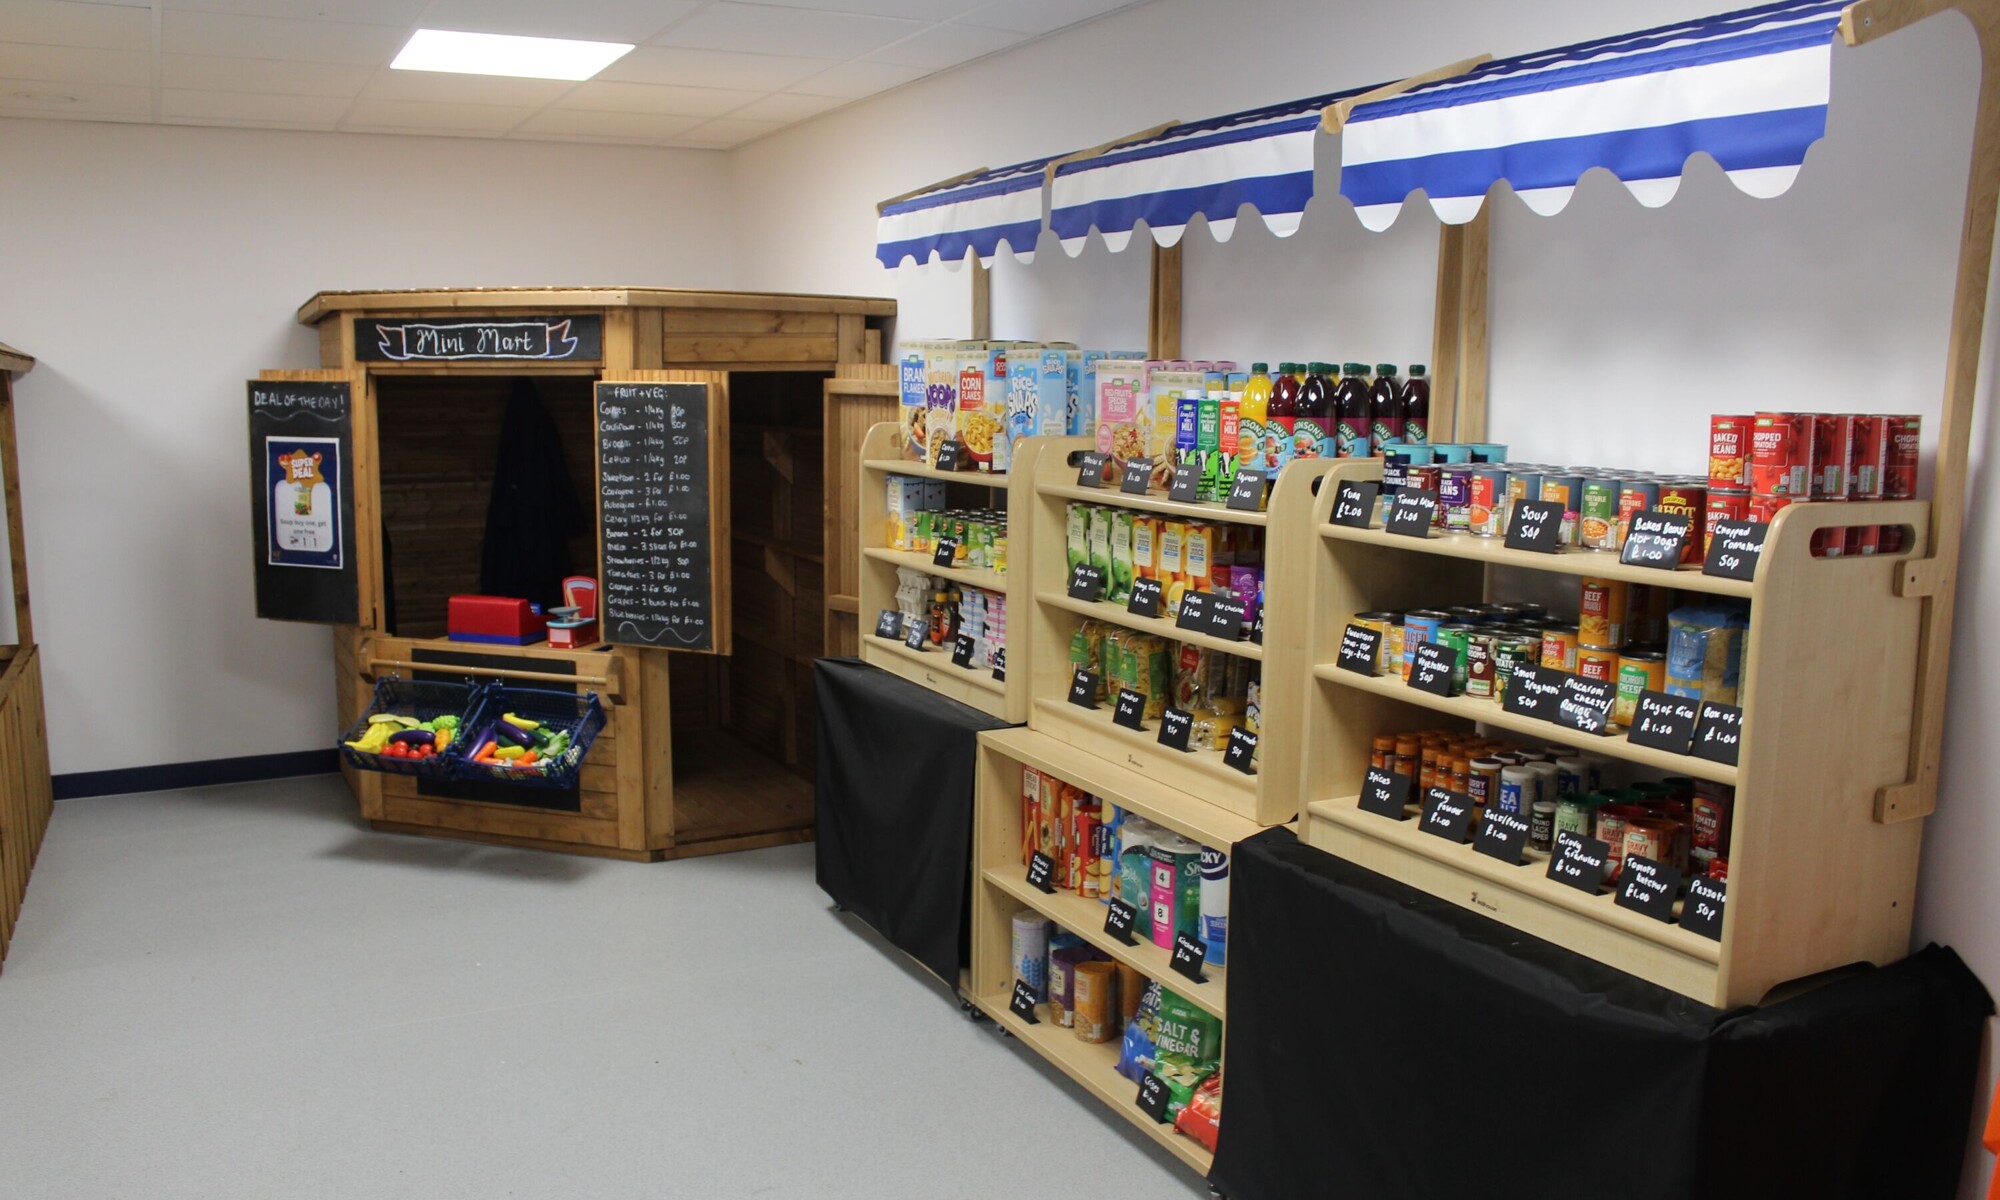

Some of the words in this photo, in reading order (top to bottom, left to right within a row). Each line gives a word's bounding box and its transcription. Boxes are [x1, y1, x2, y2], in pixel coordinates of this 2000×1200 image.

[417, 329, 464, 355] Mini
[477, 328, 533, 353] Mart
[903, 367, 925, 382] BRAN
[903, 382, 925, 394] FLAKES
[961, 377, 982, 391] CORN
[1012, 375, 1033, 391] Rice
[254, 391, 282, 406] DEAL
[284, 394, 296, 406] OF
[298, 396, 316, 408] THE
[615, 387, 637, 399] FRUIT
[926, 384, 956, 413] HOOPS
[961, 390, 982, 400] FLAKES
[1008, 391, 1039, 419] SNAPS
[1108, 397, 1127, 405] SPECIAL
[1181, 422, 1194, 431] MILK
[1202, 424, 1215, 432] MILK
[1223, 425, 1237, 435] MILK
[1713, 433, 1738, 444] BAKED
[1712, 444, 1737, 455] BEANS
[291, 458, 313, 467] SUPER
[292, 468, 314, 479] DEAL
[653, 472, 663, 482] for
[645, 487, 650, 496] 3
[1233, 487, 1252, 499] £1.00
[1336, 502, 1362, 519] £2.00
[1395, 508, 1418, 522] £1.00
[1521, 506, 1548, 525] Soup
[1665, 506, 1696, 519] HOT
[654, 512, 663, 523] for
[1634, 517, 1662, 532] Baked
[606, 528, 629, 538] Banana
[641, 529, 648, 537] 2
[650, 527, 662, 537] for
[1715, 524, 1751, 539] Chopped
[641, 541, 647, 551] 3
[1653, 535, 1678, 551] Dogs
[649, 571, 654, 580] 3
[1184, 593, 1202, 605] Coffee
[1584, 590, 1603, 601] BEEF
[1500, 653, 1512, 661] NEW
[1583, 664, 1603, 675] BEEF
[1564, 678, 1608, 697] Macaroni
[1619, 683, 1643, 694] CHEESE
[1642, 698, 1659, 716] Bag
[1660, 703, 1674, 716] of
[1703, 706, 1721, 720] Box
[1722, 713, 1735, 725] of
[1640, 718, 1673, 735] £1.50
[1704, 727, 1737, 744] £1.00
[1368, 771, 1391, 786] Spices
[1429, 788, 1450, 803] Curry
[1500, 788, 1517, 806] EA
[1429, 811, 1451, 827] £1.00
[1485, 823, 1508, 841] £1.00
[1555, 858, 1581, 876] £1.00
[1159, 873, 1165, 882] 4
[1625, 883, 1650, 902] £1.00
[1157, 908, 1163, 918] 8
[1157, 1018, 1188, 1040] SALT
[1190, 1029, 1200, 1046] &
